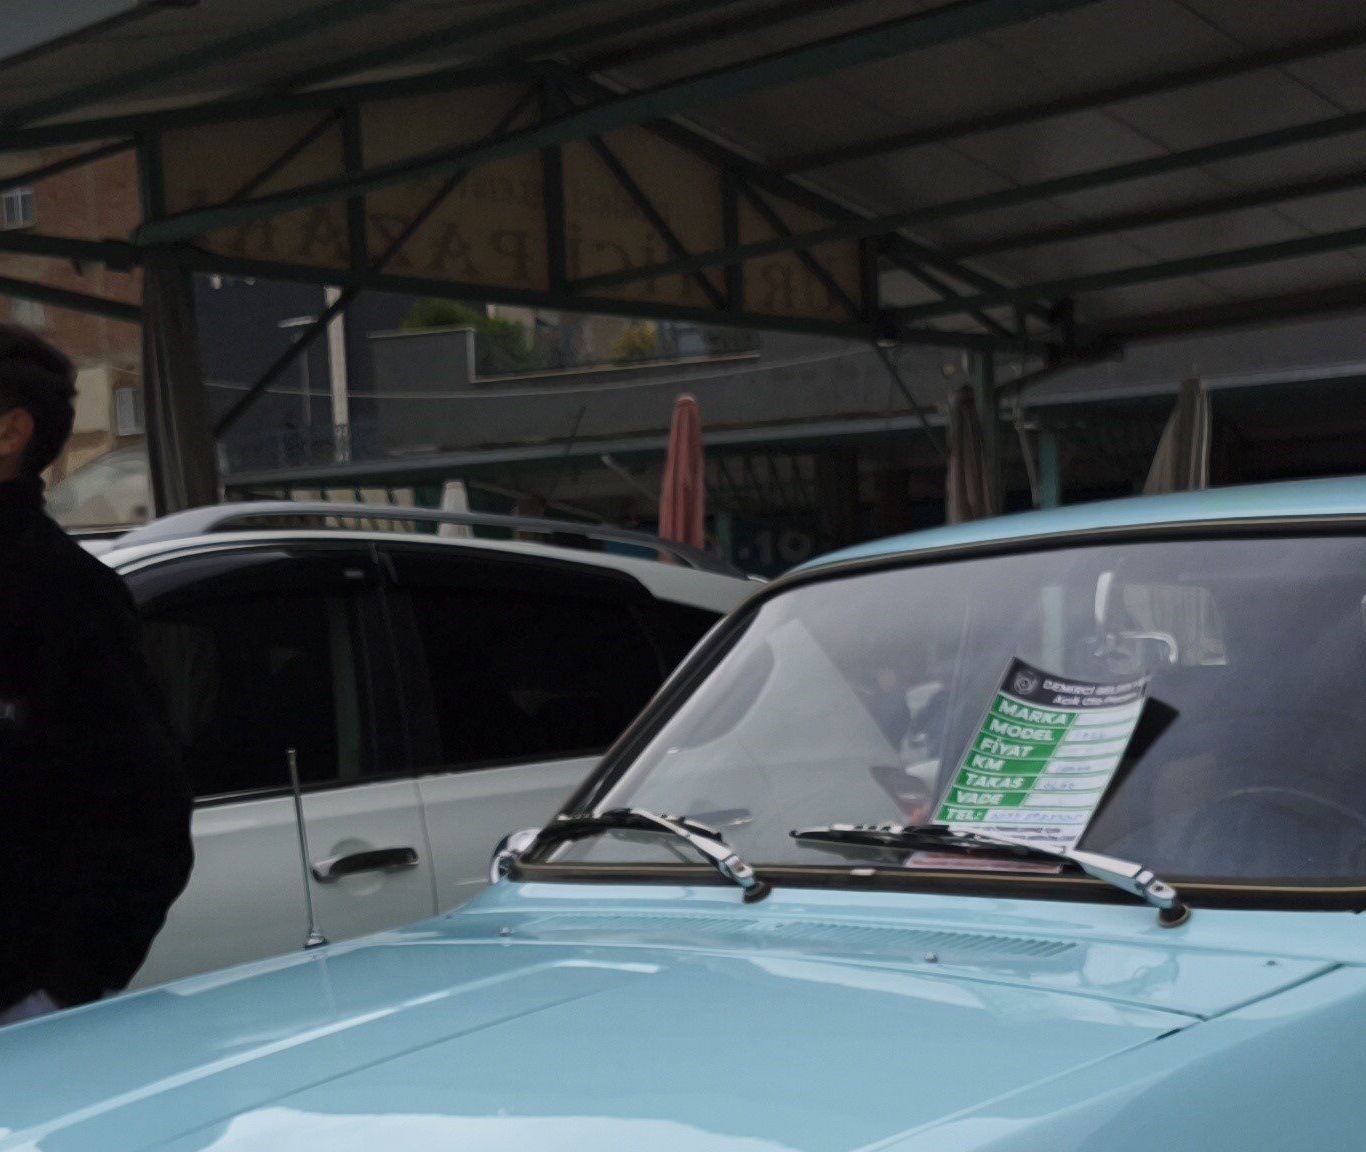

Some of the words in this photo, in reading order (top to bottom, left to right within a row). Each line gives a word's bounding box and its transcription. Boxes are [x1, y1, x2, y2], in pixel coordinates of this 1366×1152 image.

[997, 698, 1068, 726] MARKA
[988, 718, 1054, 741] MODEL
[978, 737, 1034, 758] FİYAT
[970, 754, 1006, 772] KM
[964, 772, 1025, 789] TAKAS
[956, 789, 1005, 806] VADE
